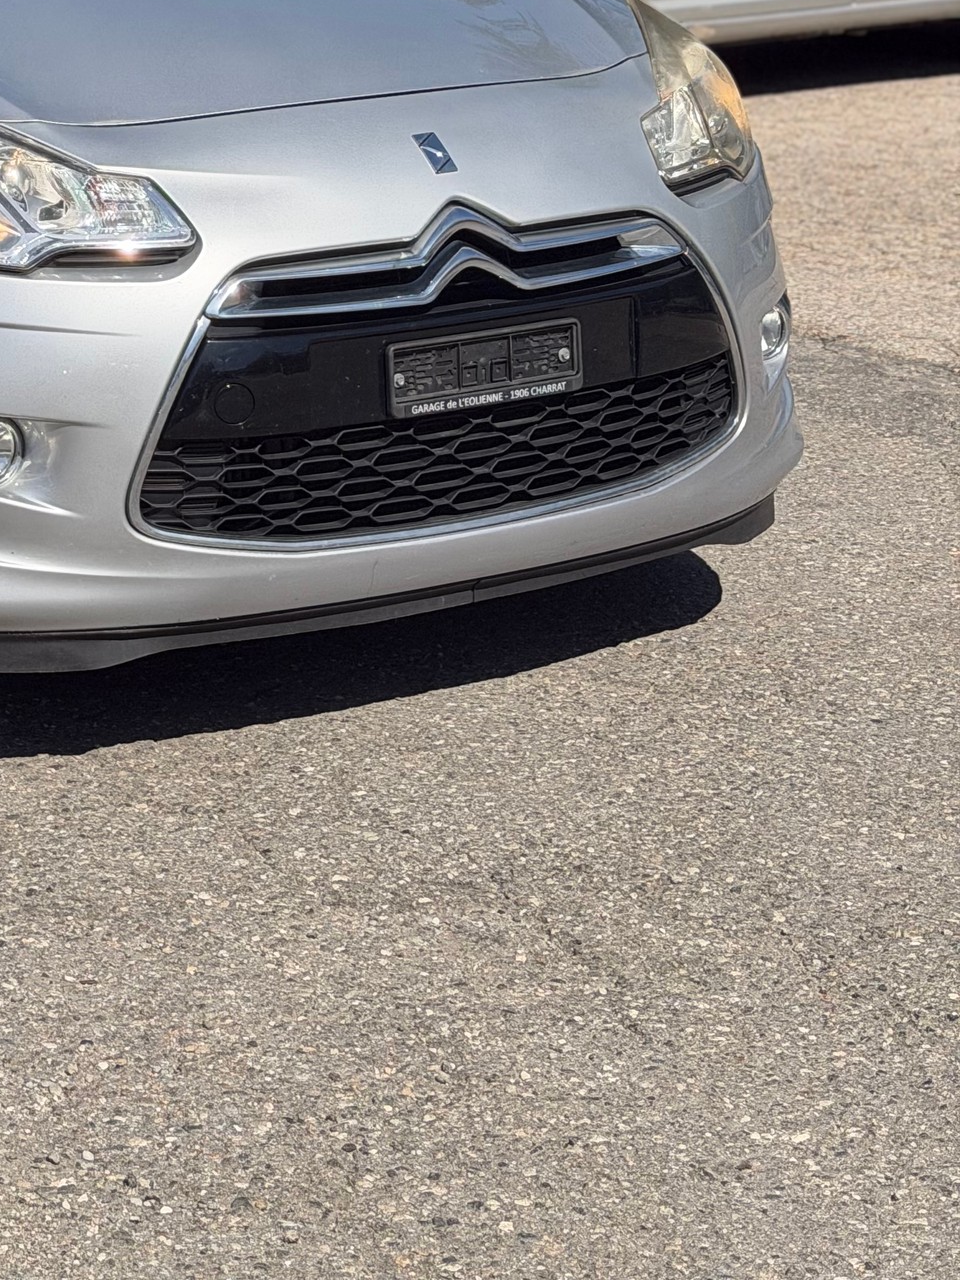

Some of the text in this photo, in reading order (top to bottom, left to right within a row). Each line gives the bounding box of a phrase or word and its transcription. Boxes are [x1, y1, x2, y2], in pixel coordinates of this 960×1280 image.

[411, 401, 445, 415] GARAGE
[446, 400, 458, 409] de
[458, 392, 504, 408] L'EOLIENNE
[510, 388, 530, 399] 1906
[530, 381, 567, 396] CHARRAT
